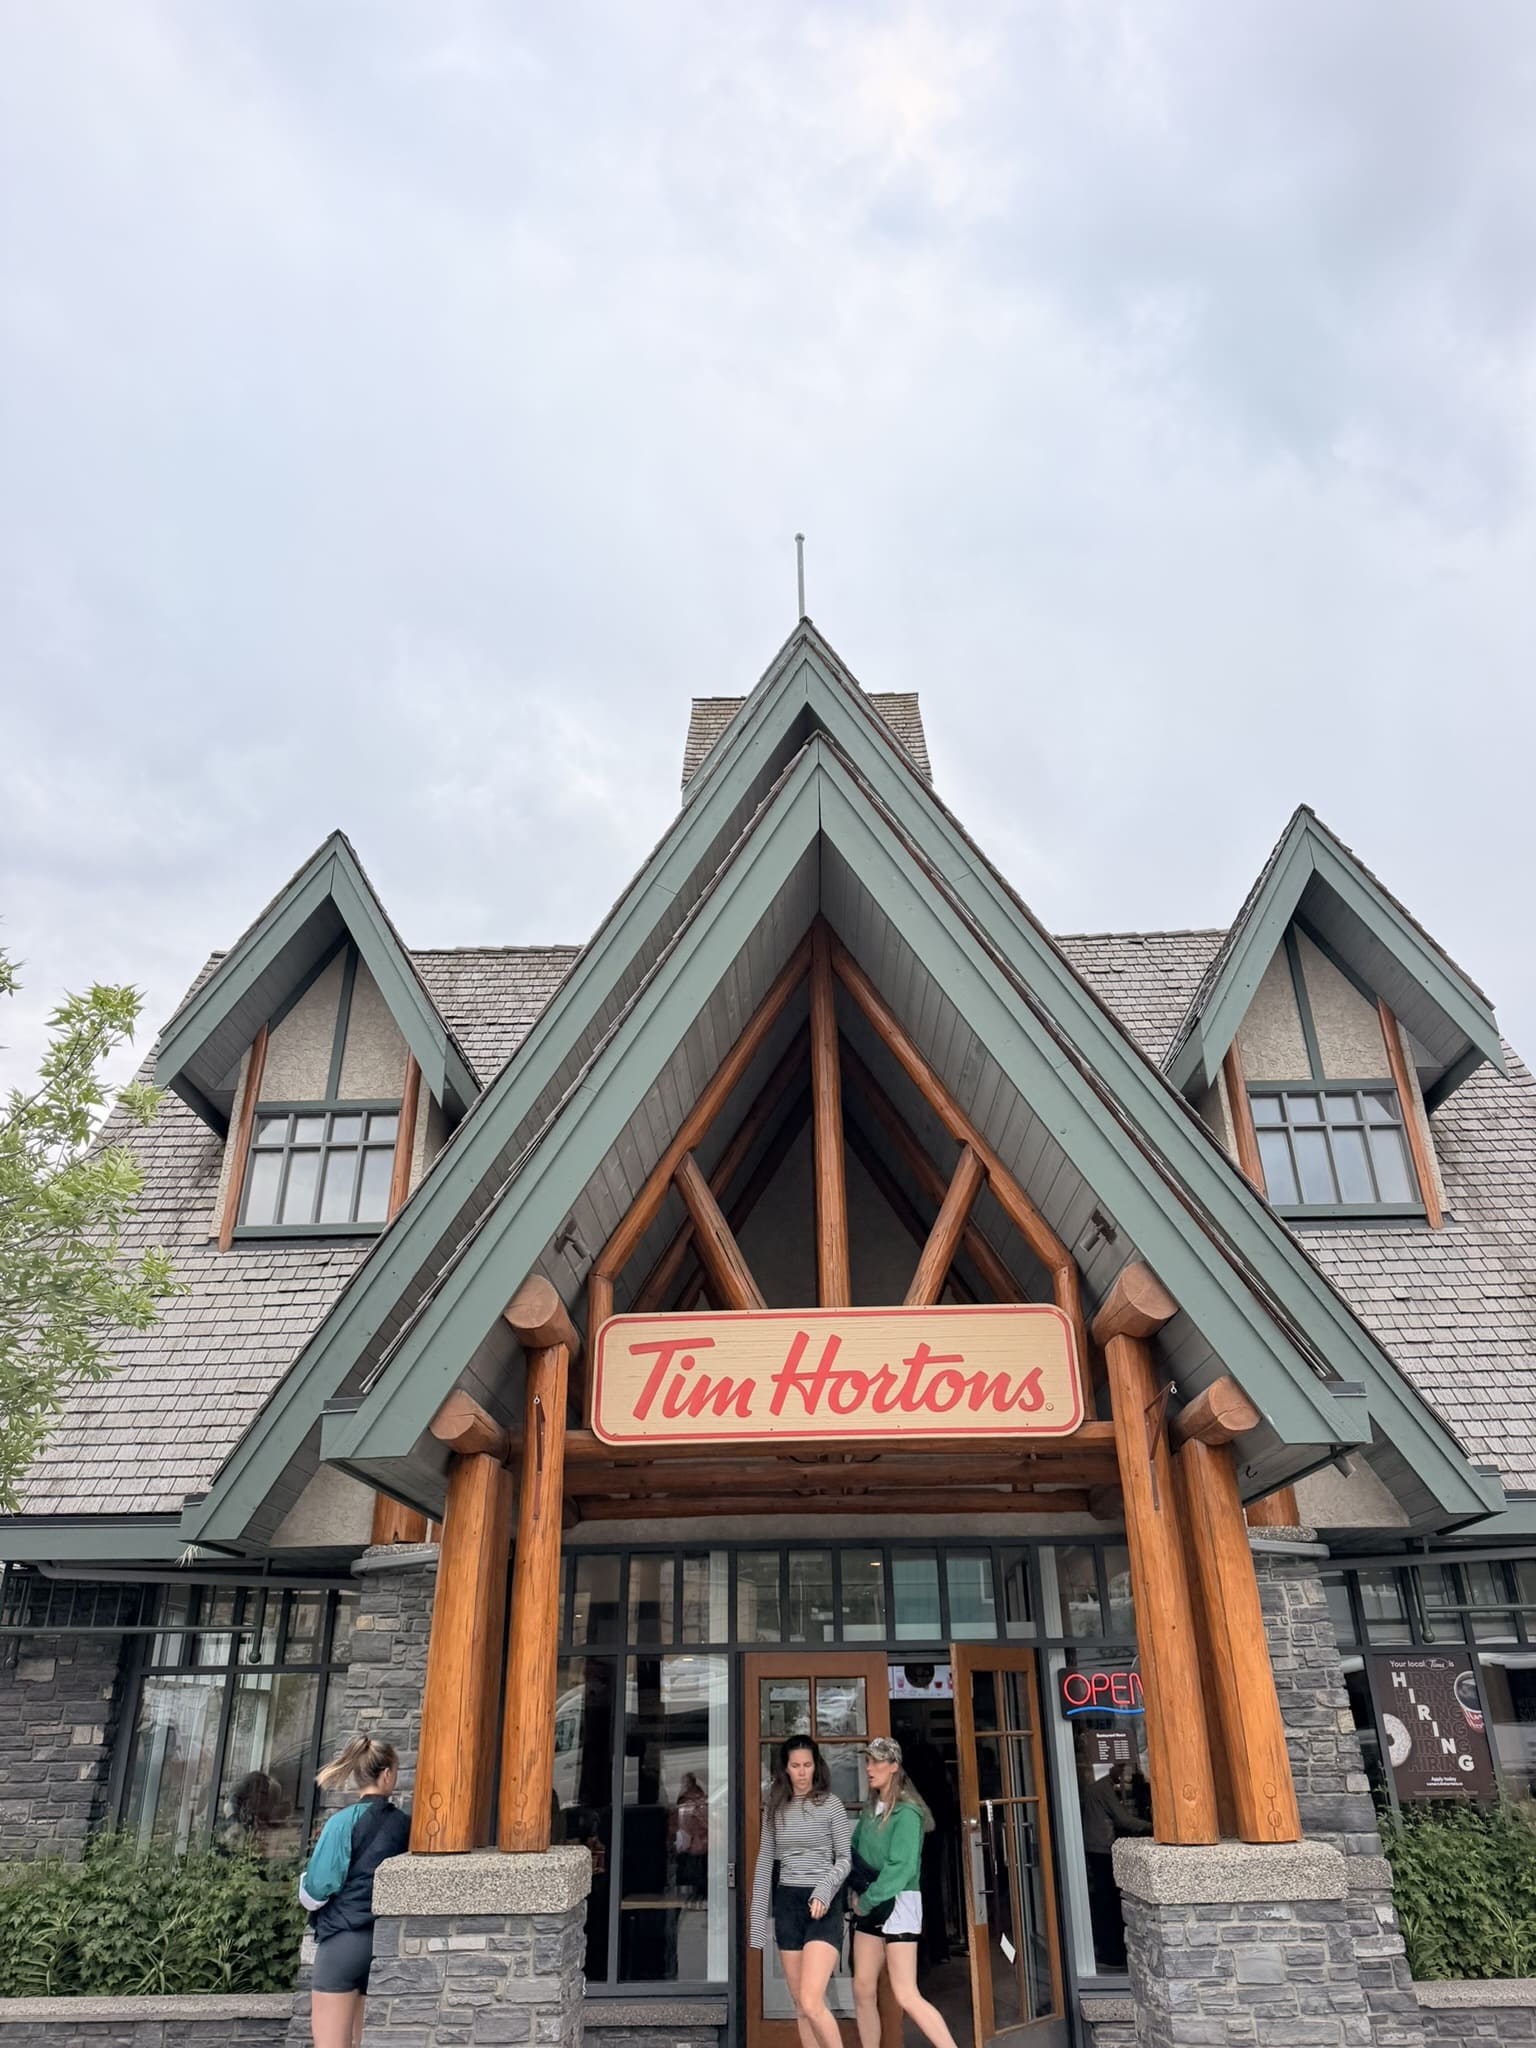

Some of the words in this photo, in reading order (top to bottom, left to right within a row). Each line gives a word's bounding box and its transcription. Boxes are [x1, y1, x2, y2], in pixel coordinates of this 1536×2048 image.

[628, 1337, 756, 1421] Tim
[770, 1330, 1045, 1416] Hortons
[1389, 1659, 1406, 1668] Your
[1407, 1659, 1425, 1668] local
